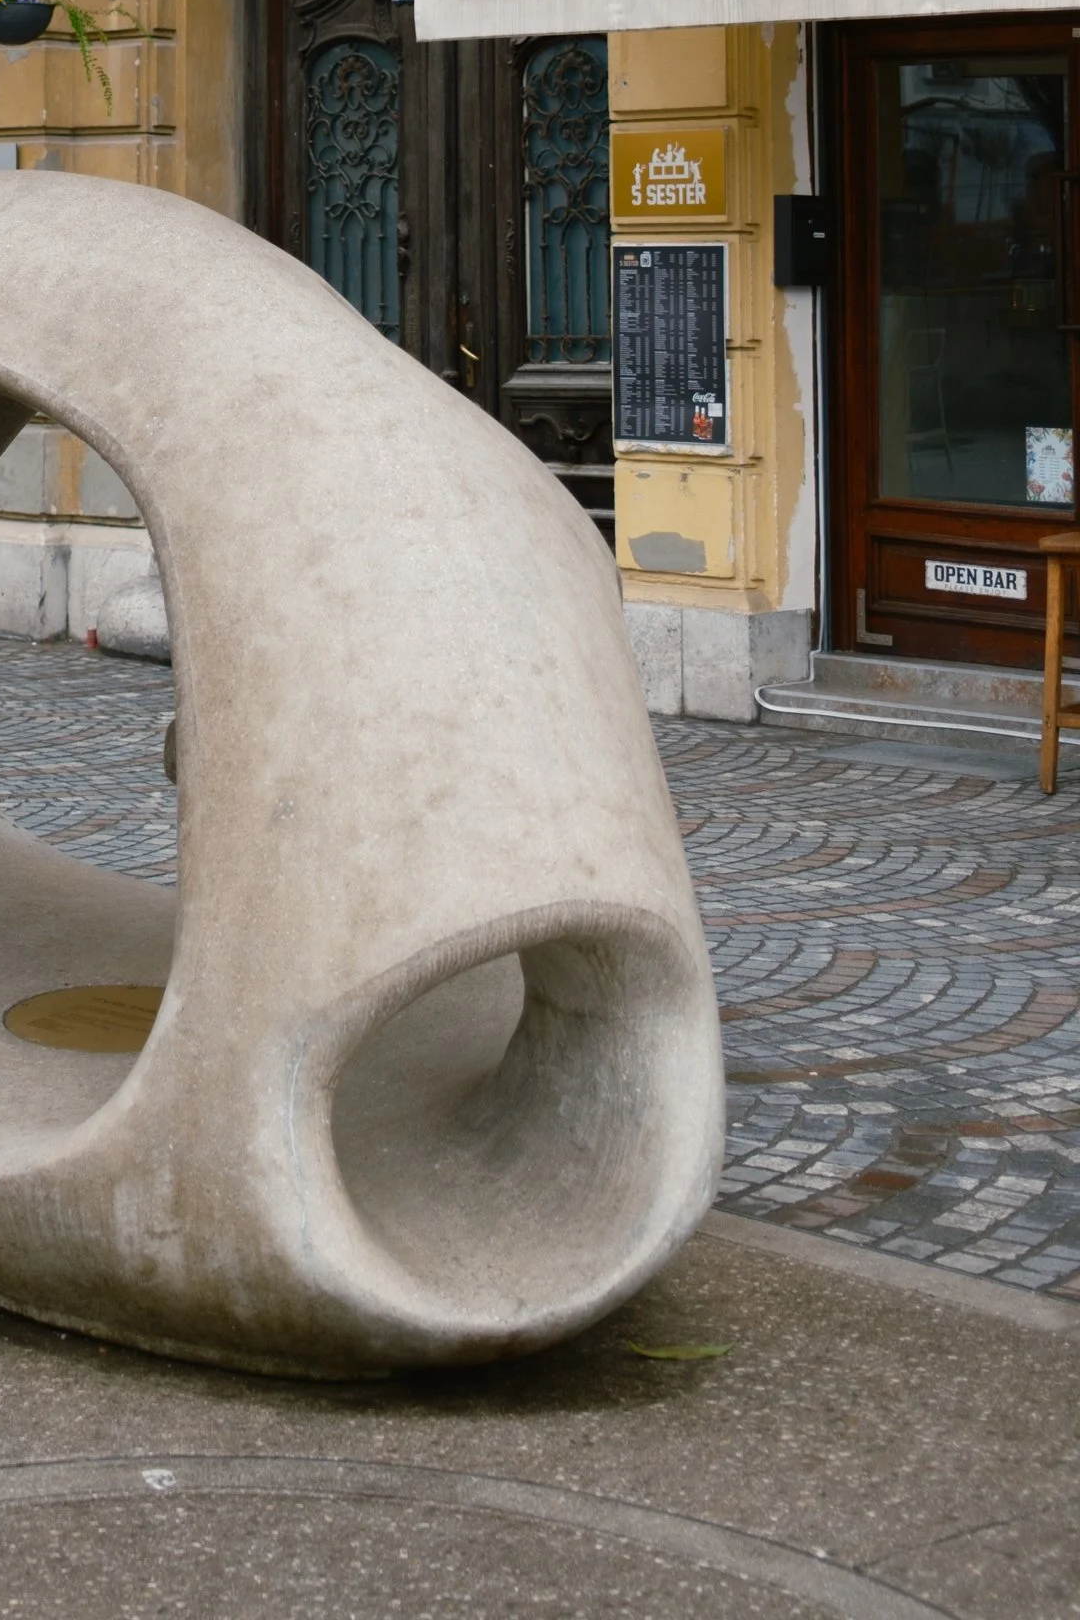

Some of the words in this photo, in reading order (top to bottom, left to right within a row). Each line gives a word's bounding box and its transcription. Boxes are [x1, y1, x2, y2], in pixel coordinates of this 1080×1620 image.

[631, 184, 642, 206] 5
[646, 183, 706, 206] SESTER
[934, 564, 978, 586] OPEN
[983, 569, 1017, 590] BAR
